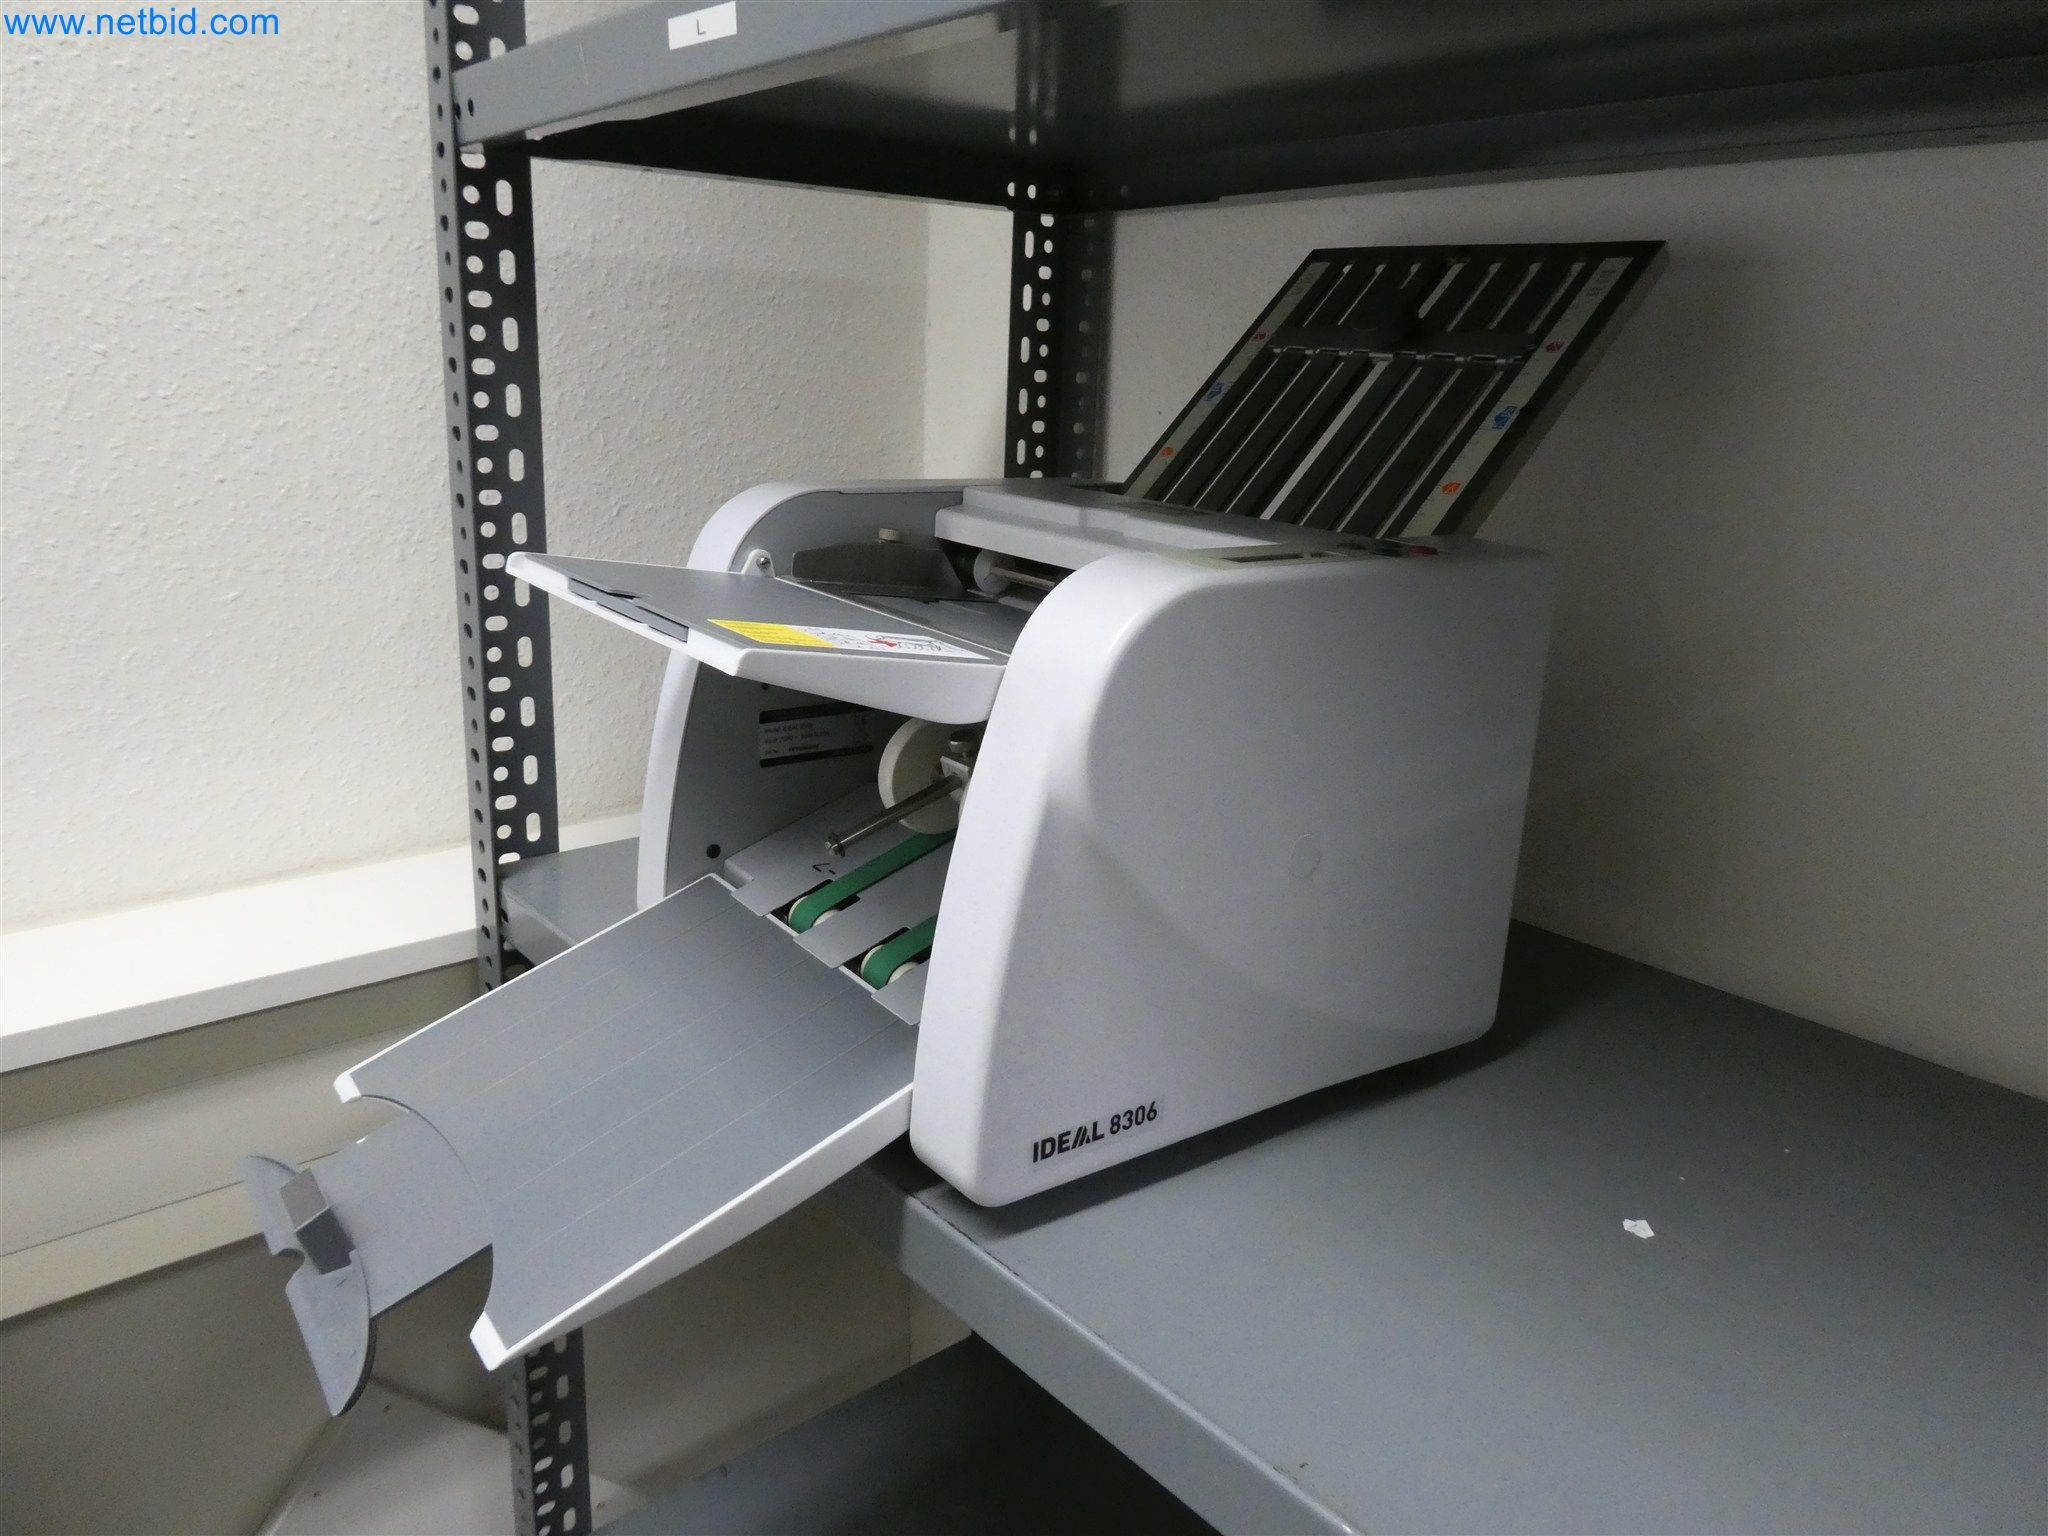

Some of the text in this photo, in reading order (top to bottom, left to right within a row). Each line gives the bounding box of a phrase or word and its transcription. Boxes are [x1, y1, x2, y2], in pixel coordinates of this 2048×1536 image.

[696, 18, 706, 35] L
[1032, 1100, 1158, 1163] IDEAL 8306
